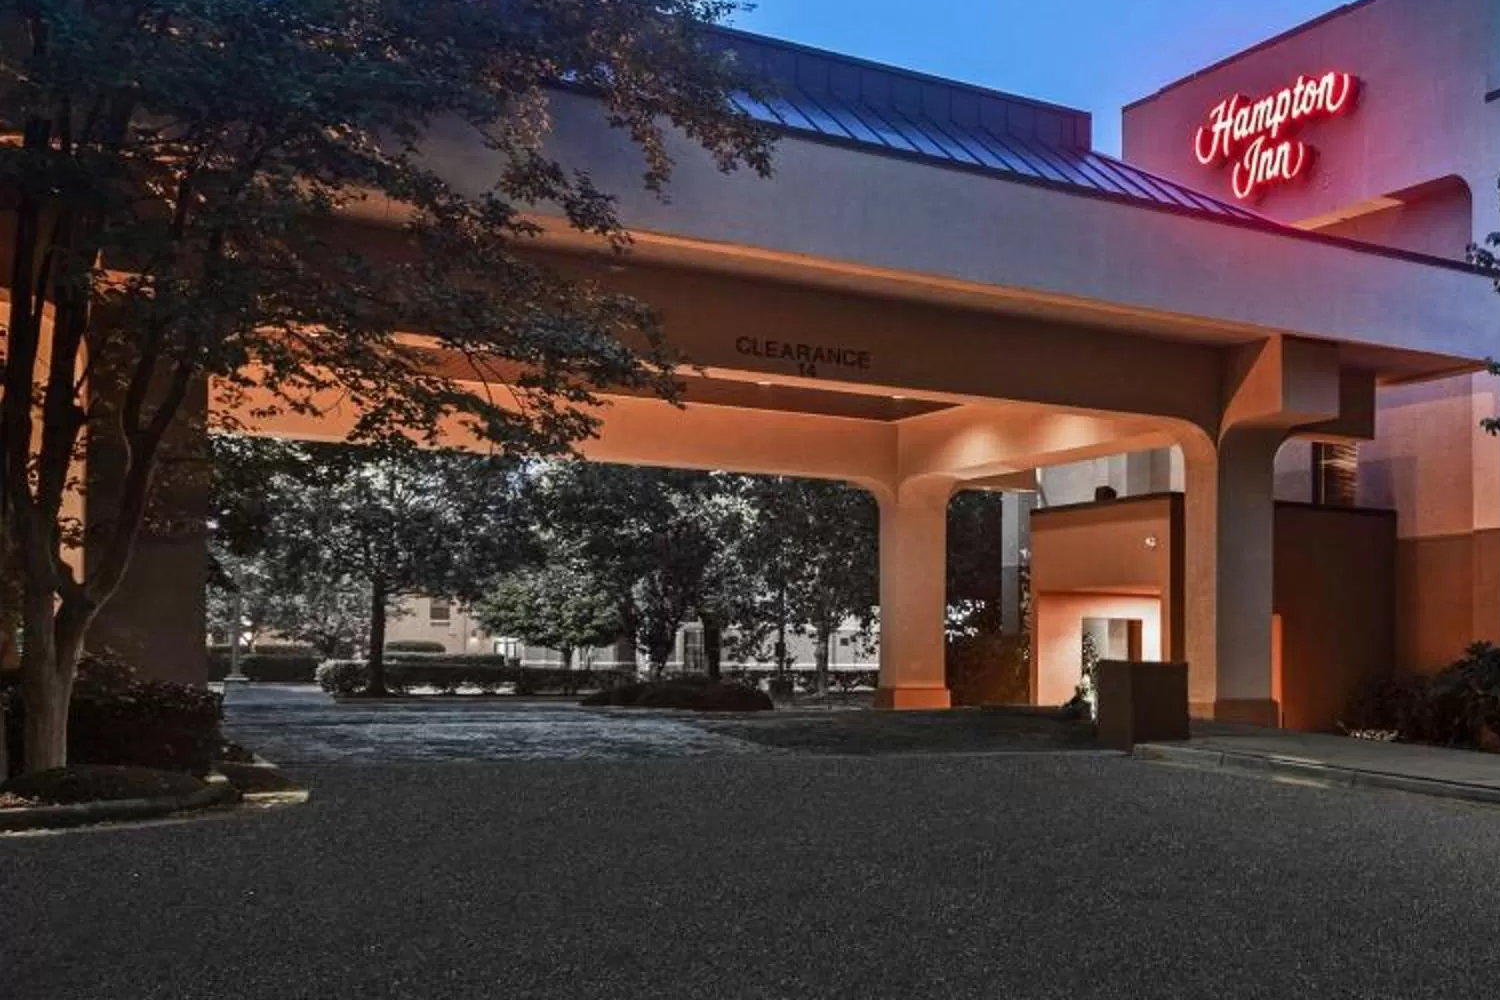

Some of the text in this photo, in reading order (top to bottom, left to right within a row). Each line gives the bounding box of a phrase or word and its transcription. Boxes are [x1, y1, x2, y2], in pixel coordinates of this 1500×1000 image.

[1194, 71, 1350, 165] Hampton
[1231, 135, 1305, 199] Inn
[735, 335, 873, 369] CLEARANCE
